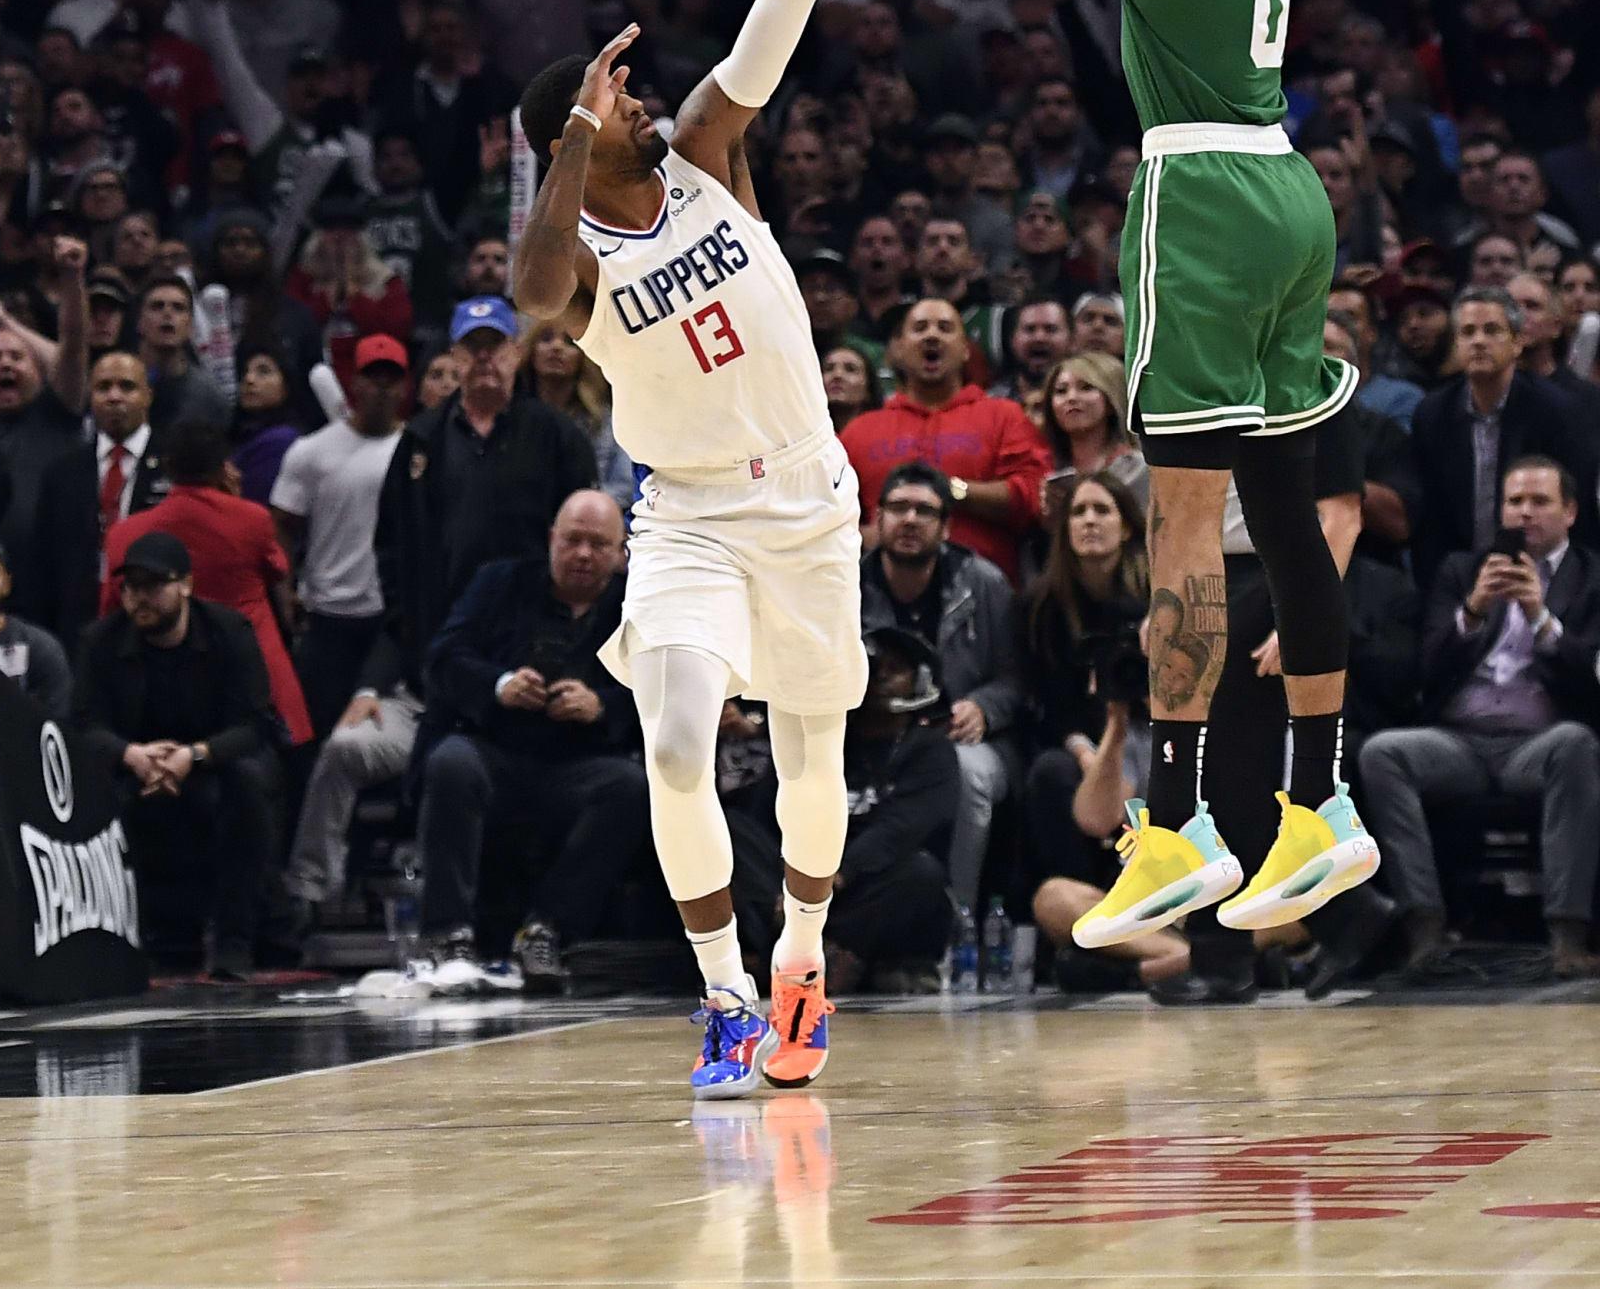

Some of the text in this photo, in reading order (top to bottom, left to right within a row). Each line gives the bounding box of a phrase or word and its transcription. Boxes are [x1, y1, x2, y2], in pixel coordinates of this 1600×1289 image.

[670, 187, 703, 217] bumble
[609, 219, 749, 335] CLIPPERS
[680, 300, 746, 375] 13
[20, 817, 142, 958] SPALDING
